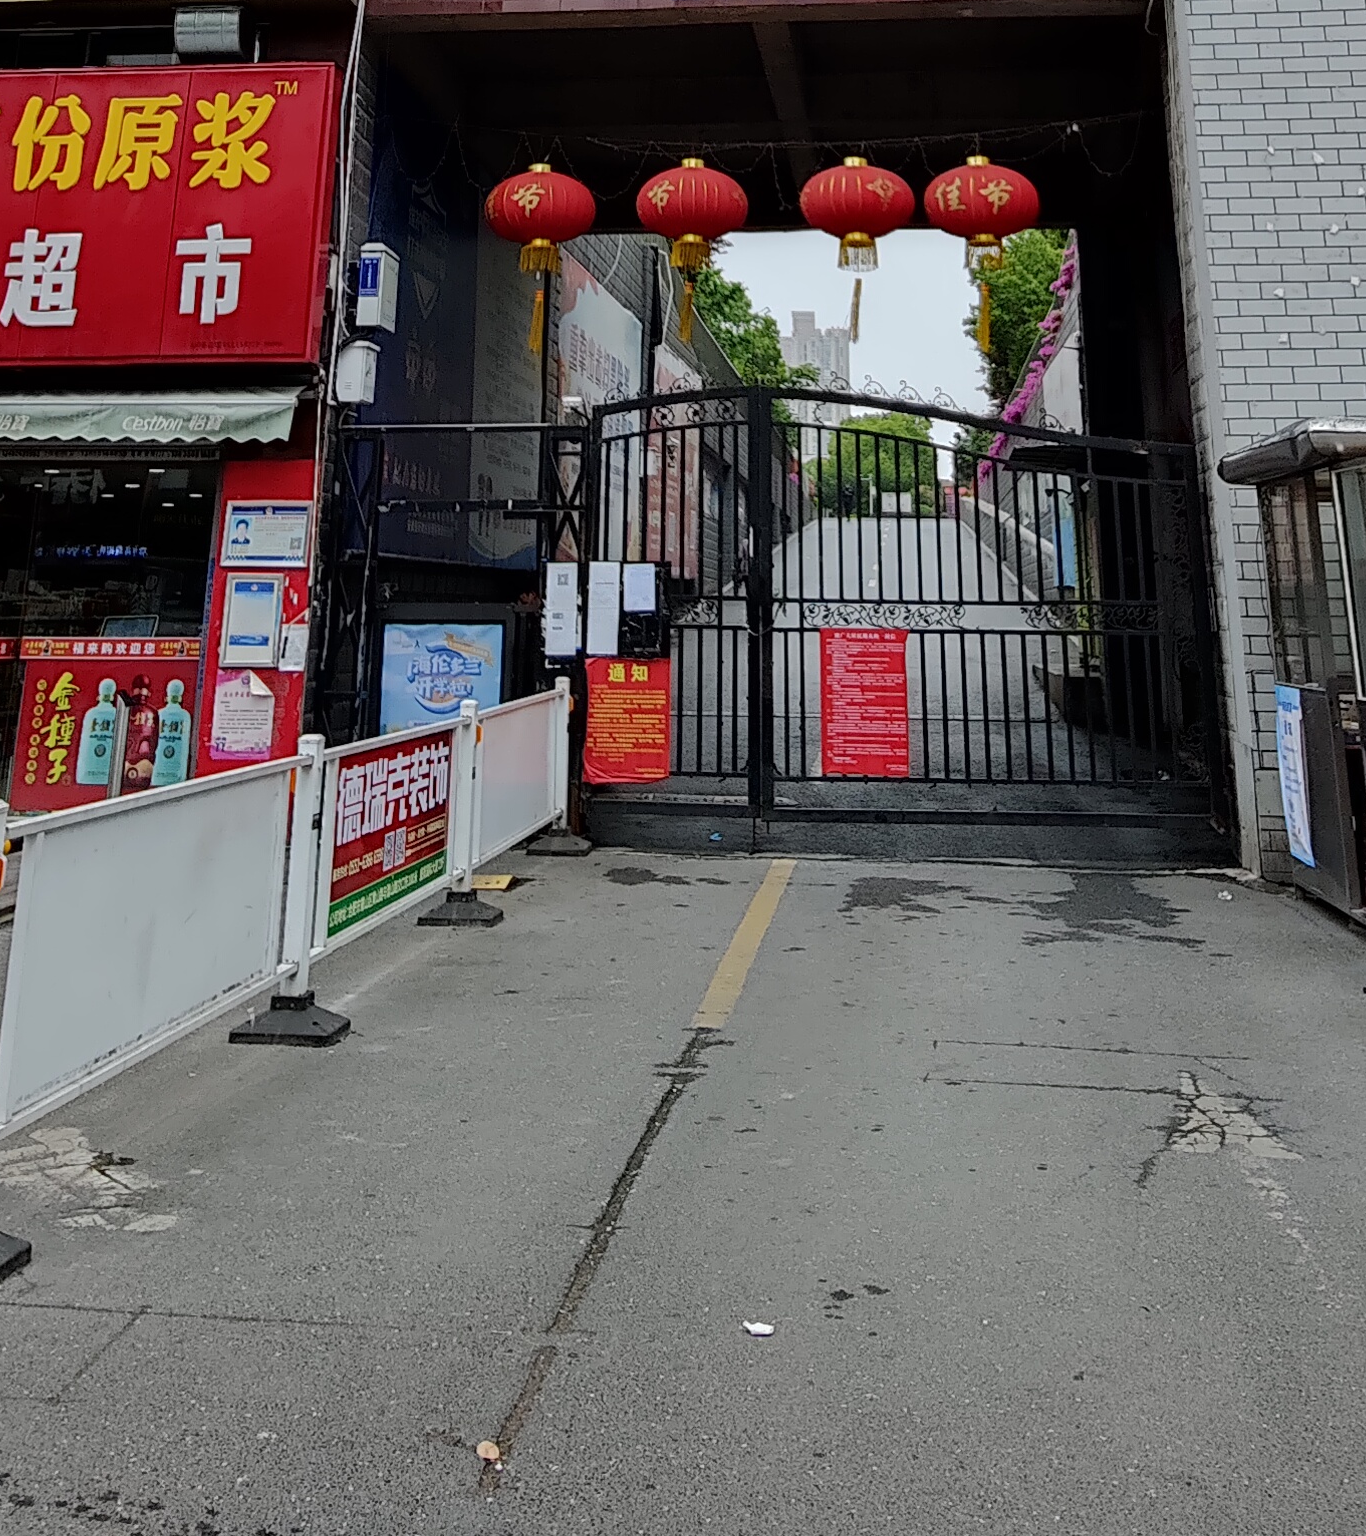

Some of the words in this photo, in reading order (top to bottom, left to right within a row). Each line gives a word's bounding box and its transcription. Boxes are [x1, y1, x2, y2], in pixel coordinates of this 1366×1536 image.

[935, 176, 1014, 215] 佳节
[122, 413, 184, 432] Cestbon
[72, 641, 156, 655] 福来购欢迎您
[607, 663, 649, 683] 通知
[40, 671, 81, 785] 金種子
[336, 740, 450, 847] 德瑞克装饰
